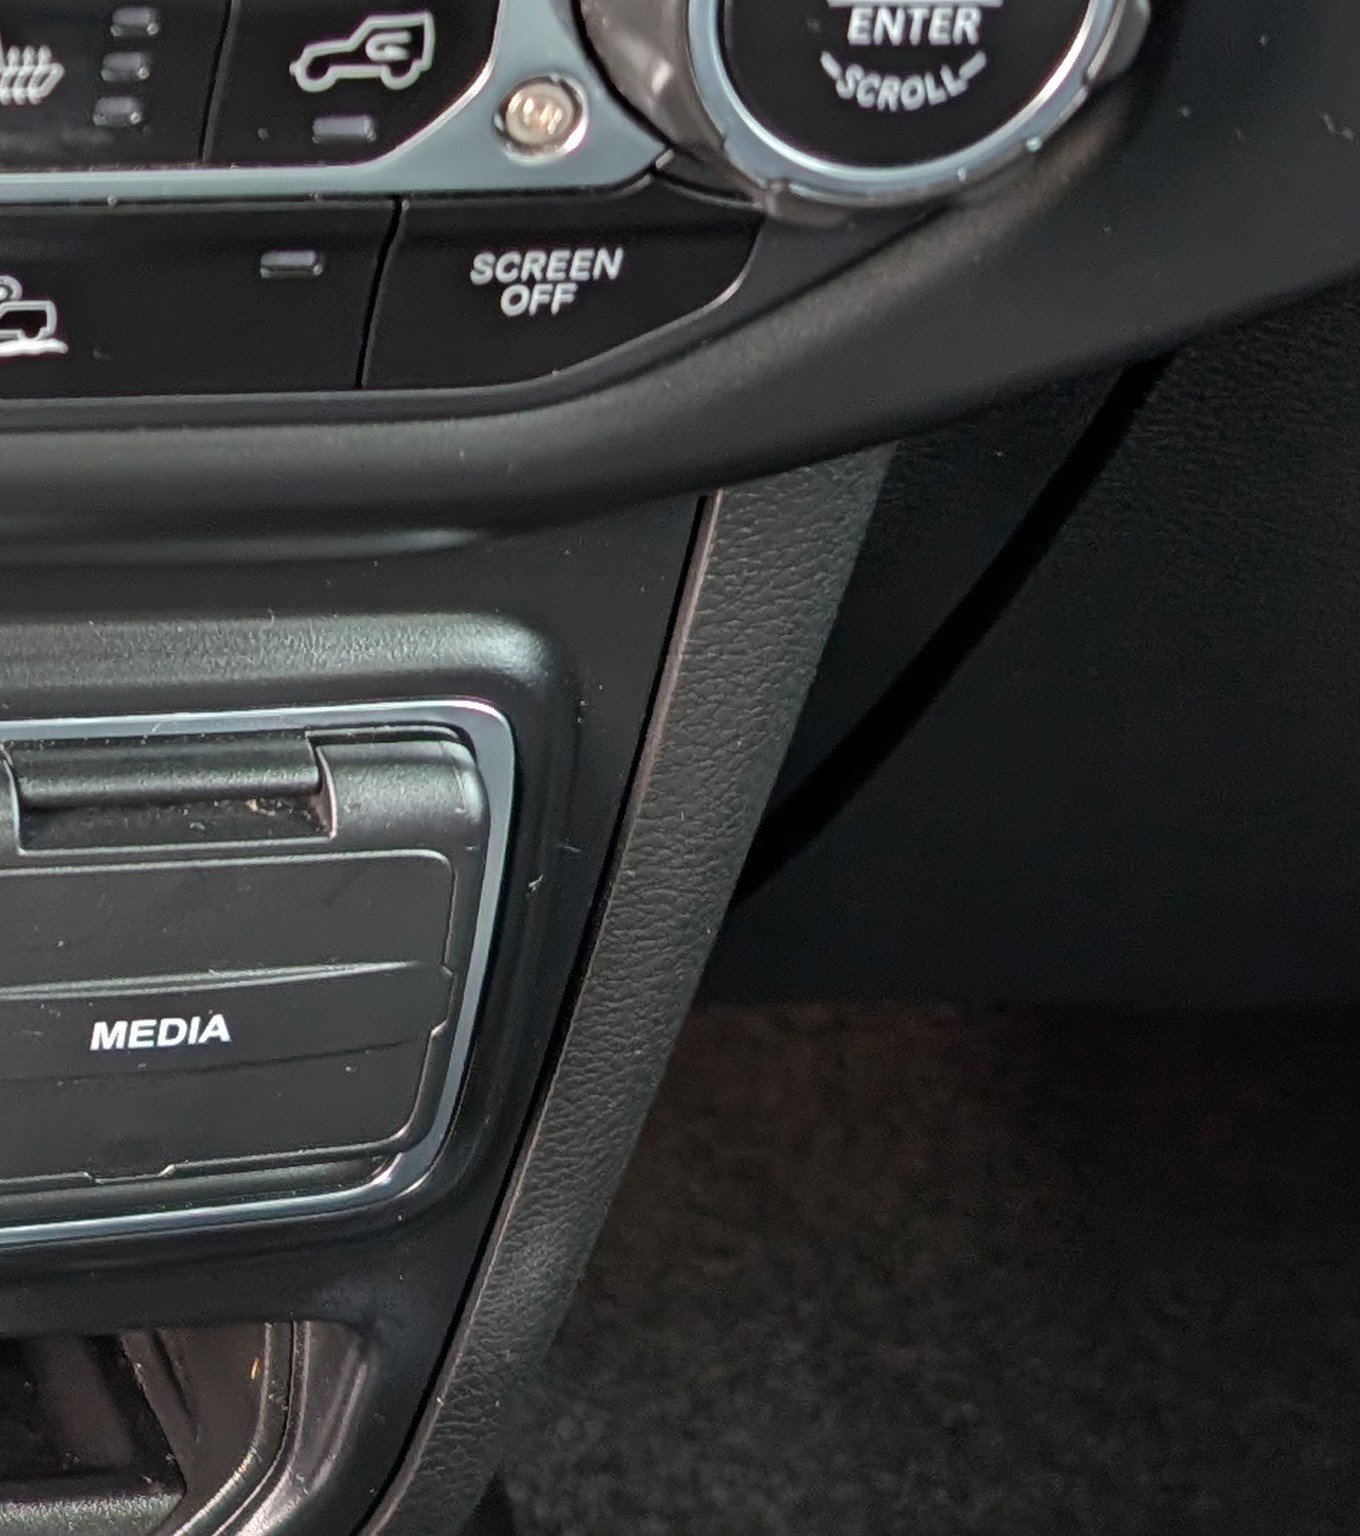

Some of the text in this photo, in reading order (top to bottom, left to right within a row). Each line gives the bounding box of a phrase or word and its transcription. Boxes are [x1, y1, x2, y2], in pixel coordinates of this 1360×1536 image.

[846, 7, 983, 46] ENTER
[835, 64, 966, 113] SCROLL
[469, 248, 625, 284] SCREEN
[499, 283, 578, 317] OFF
[89, 1013, 233, 1052] MEDIA
